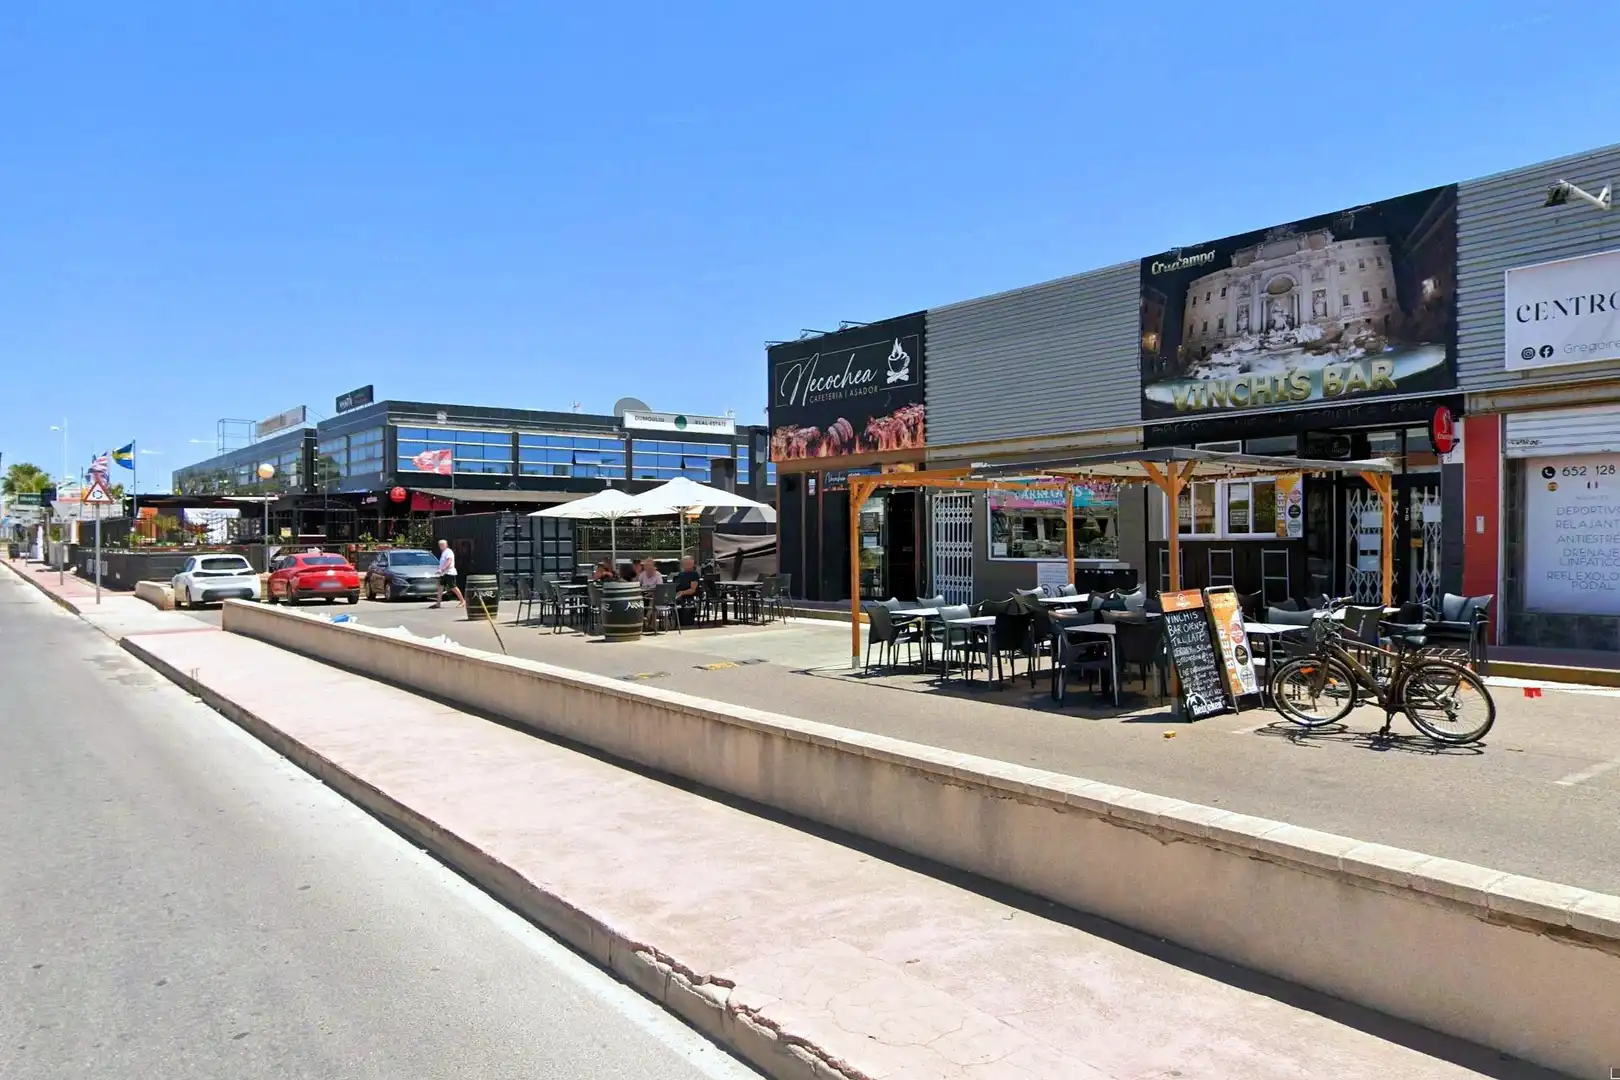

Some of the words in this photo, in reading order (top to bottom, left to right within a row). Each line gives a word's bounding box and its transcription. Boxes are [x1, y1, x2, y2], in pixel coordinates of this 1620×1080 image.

[1151, 250, 1216, 275] Cruzcampo
[780, 353, 877, 406] Necochea
[1171, 367, 1312, 412] VINCHI'S
[1322, 360, 1397, 397] BAR
[809, 392, 843, 403] CAFETERIA
[849, 386, 878, 397] ASADOR
[1562, 466, 1587, 477] 652
[1595, 464, 1616, 476] 128
[1277, 493, 1286, 520] BEER
[1563, 548, 1620, 557] DRENAJE
[1571, 581, 1616, 590] PODAL
[1167, 624, 1183, 636] BAR
[1219, 630, 1235, 669] BEER
[1192, 700, 1224, 715] Heineken
